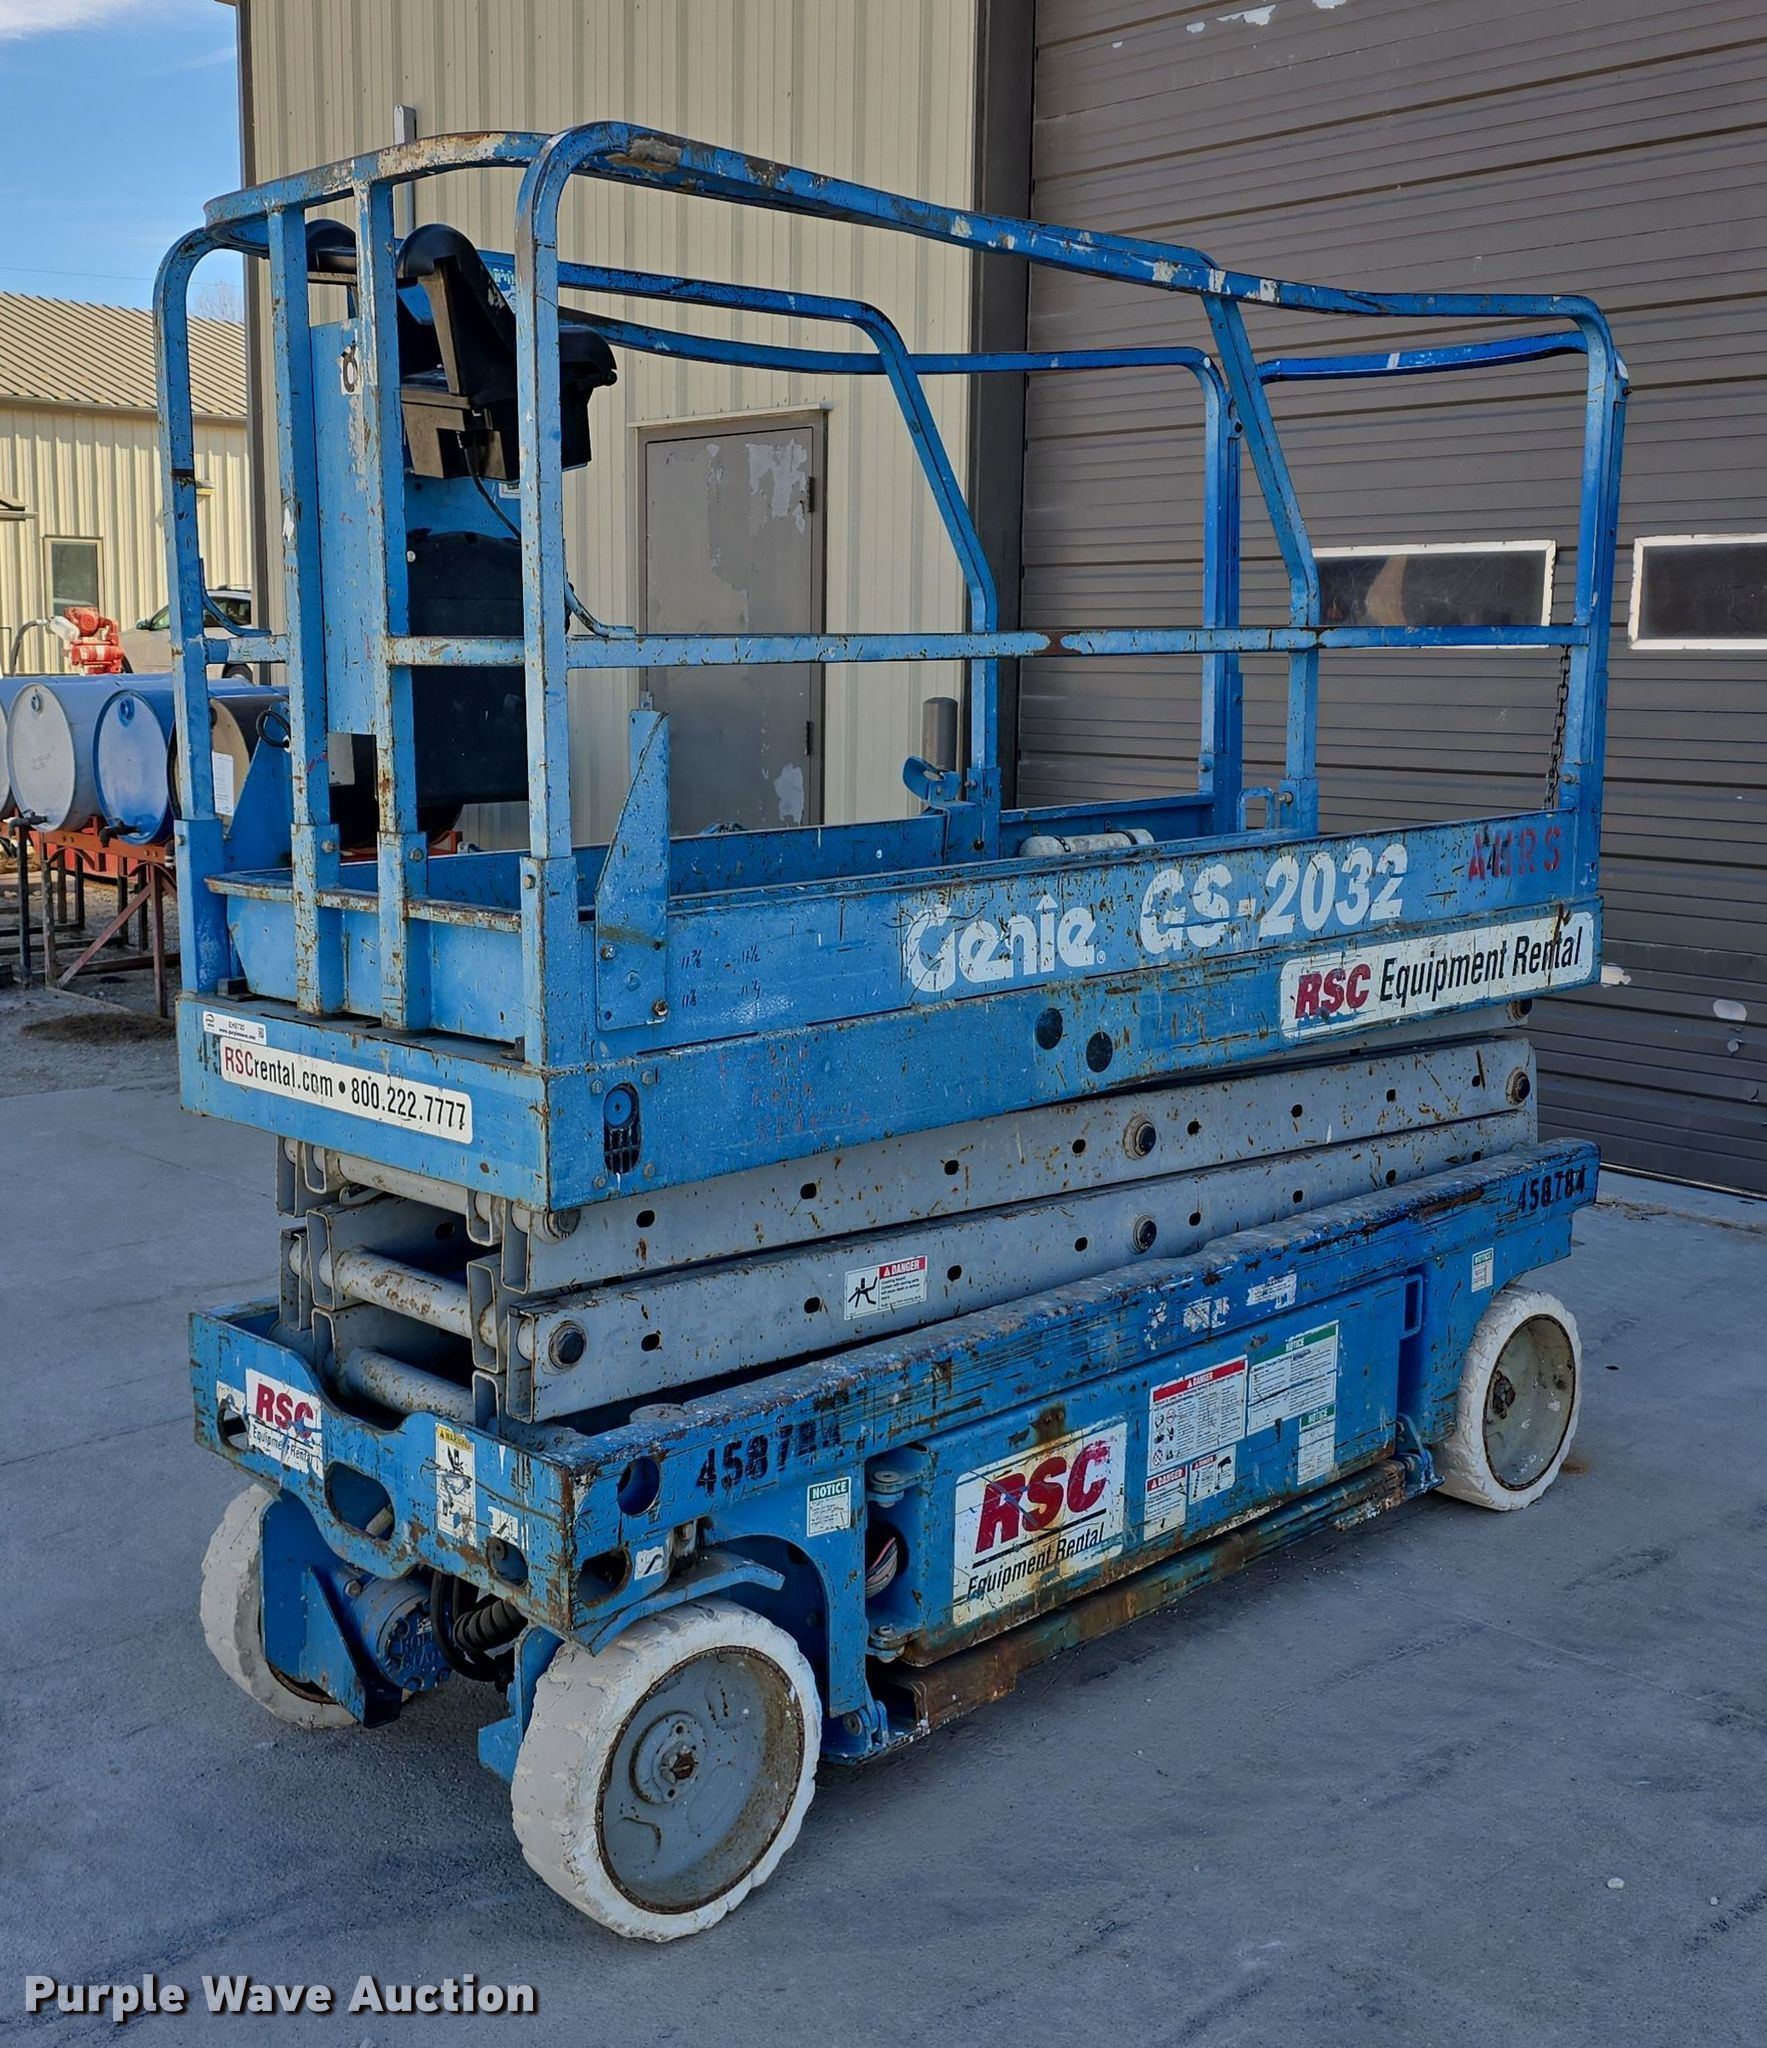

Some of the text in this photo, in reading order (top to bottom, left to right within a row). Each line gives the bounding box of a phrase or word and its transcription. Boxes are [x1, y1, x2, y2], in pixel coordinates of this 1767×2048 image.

[1140, 843, 1408, 954] GS-2032
[1295, 926, 1583, 1019] RSC Equipment Rental
[224, 1046, 466, 1131] RSCrental.com 800.222.7777
[891, 1259, 920, 1276] DANGER
[255, 1383, 314, 1439] RSC
[812, 1481, 847, 1500] NOTICE
[974, 1439, 1112, 1555] RSC
[1157, 1468, 1184, 1486] DANGER
[967, 1522, 1106, 1601] Equipment Rental
